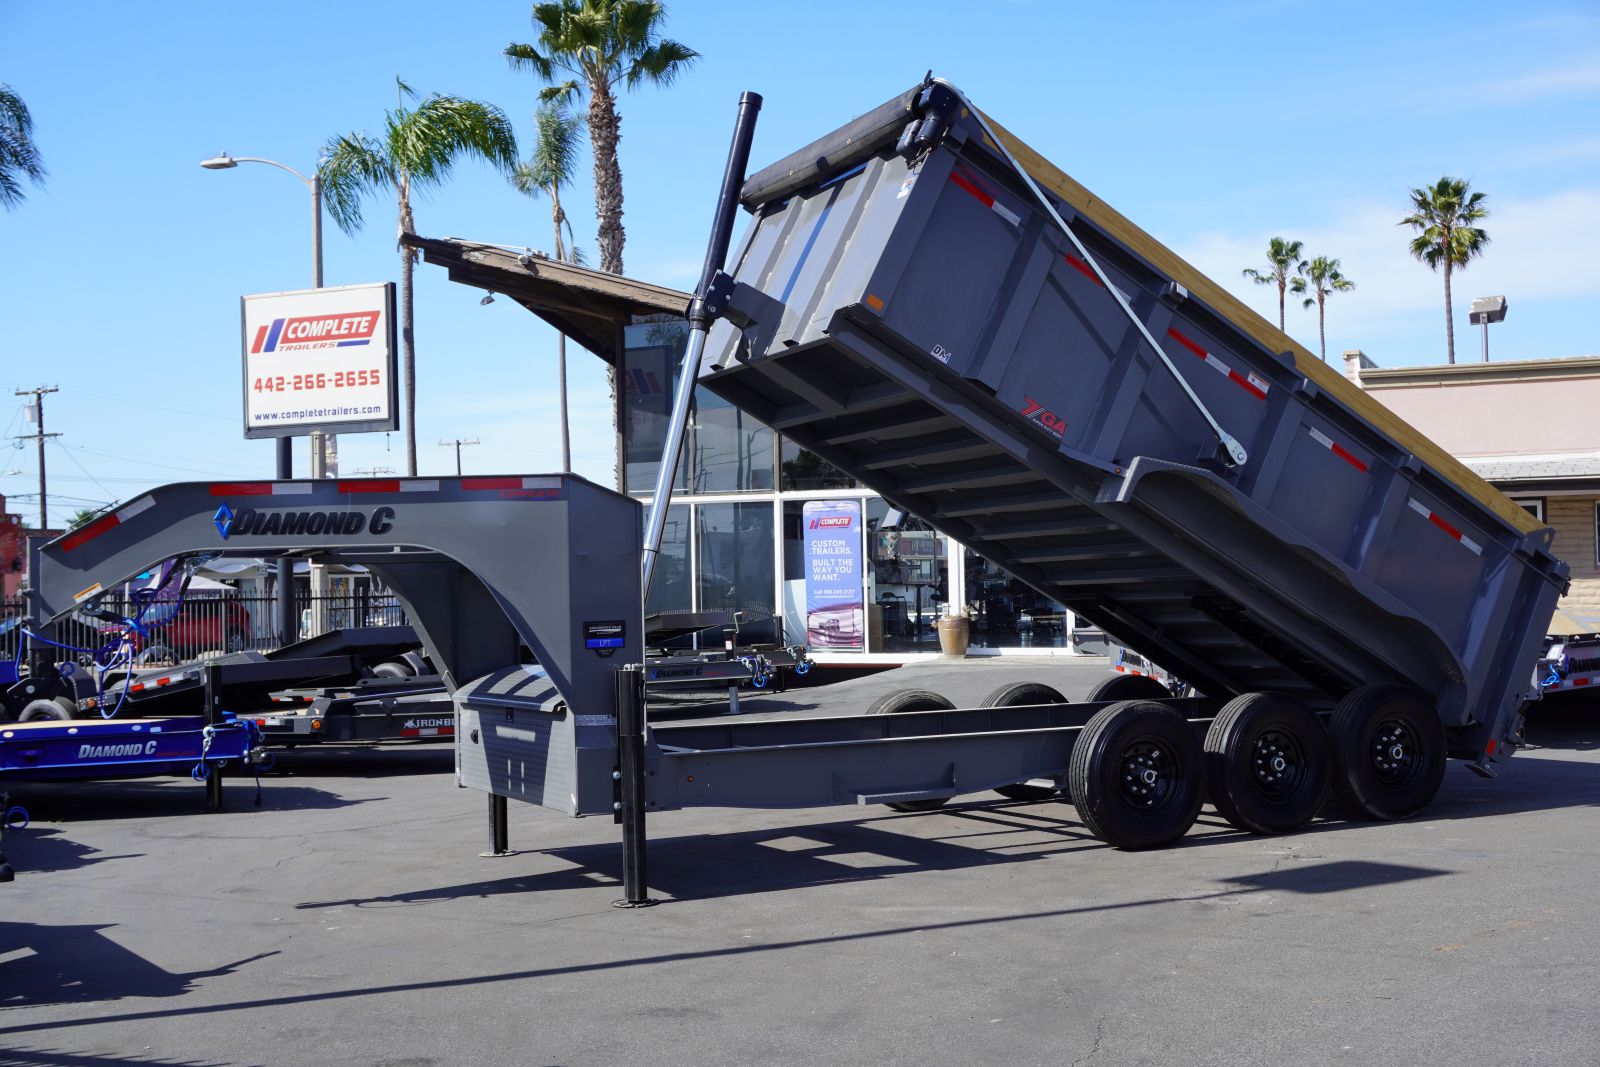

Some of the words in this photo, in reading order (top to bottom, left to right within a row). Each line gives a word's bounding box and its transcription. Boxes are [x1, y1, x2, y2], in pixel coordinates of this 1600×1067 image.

[287, 316, 372, 339] COMPLETE
[278, 341, 337, 352] TRAILERS
[254, 369, 380, 393] 442-266-2655
[255, 405, 381, 420] www.completetrailers.com
[229, 507, 366, 535] DIAMOND
[369, 506, 396, 535] C
[812, 547, 853, 555] TRAILERS.
[813, 559, 835, 567] BUILT
[813, 566, 832, 574] WAY
[656, 668, 695, 678] DIAMOND
[78, 744, 143, 758] DIAMOND
[144, 740, 157, 755] C
